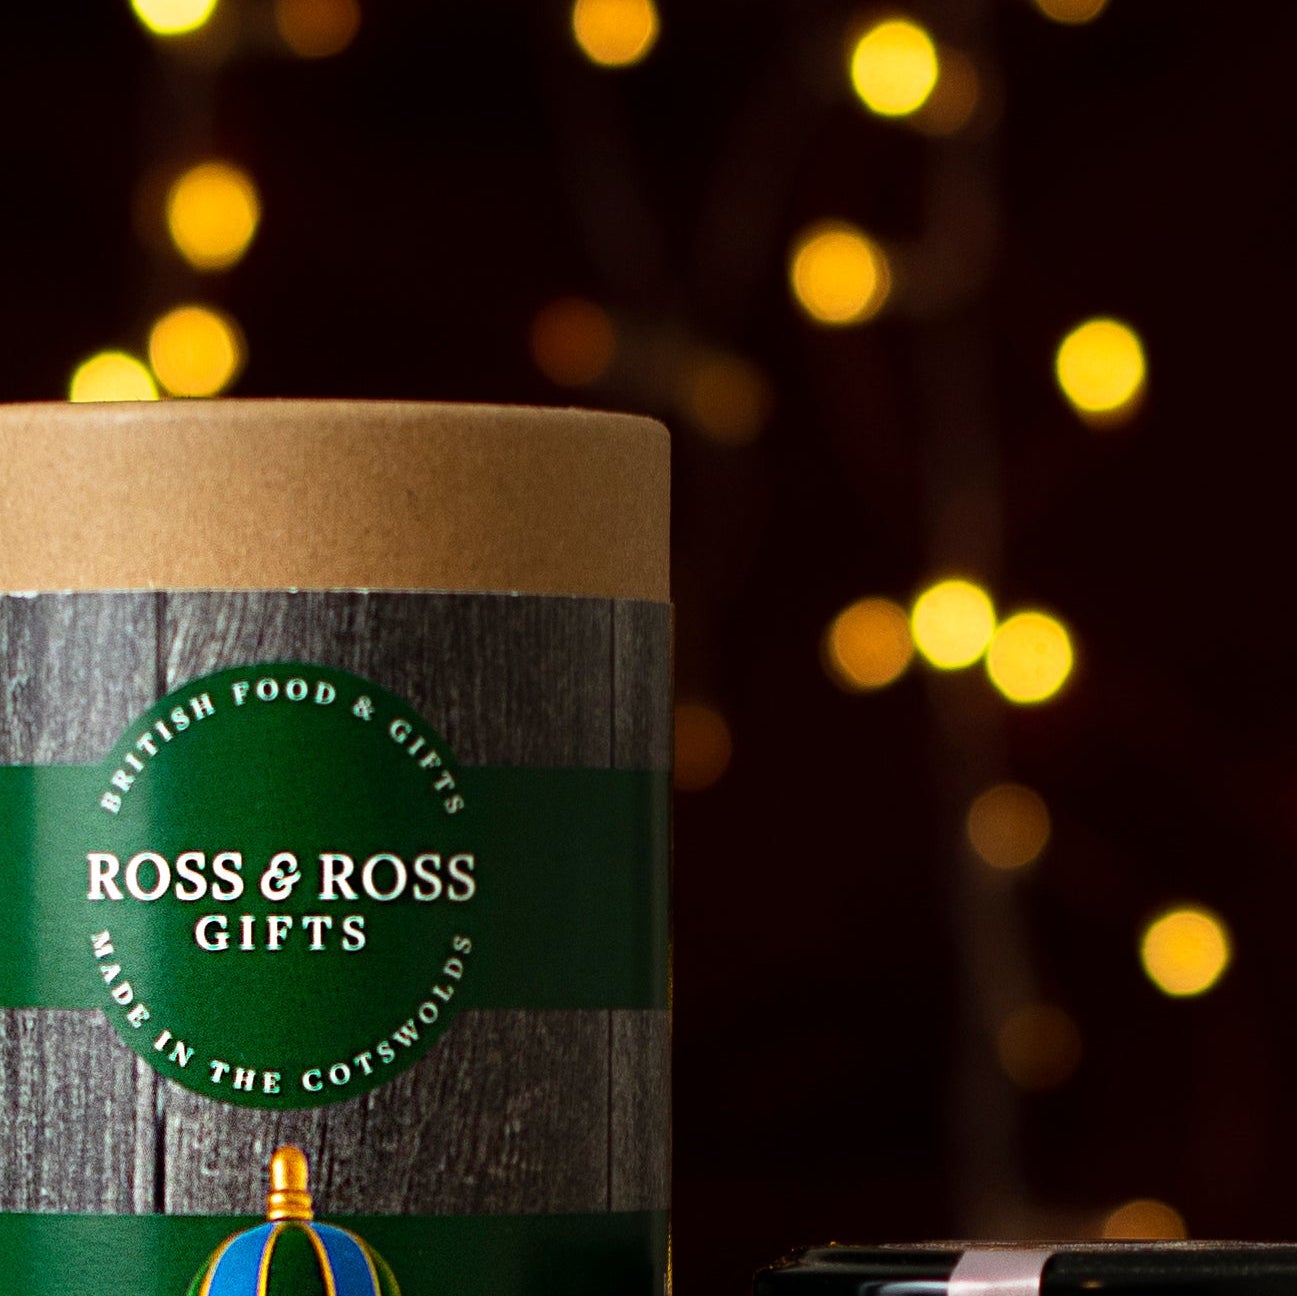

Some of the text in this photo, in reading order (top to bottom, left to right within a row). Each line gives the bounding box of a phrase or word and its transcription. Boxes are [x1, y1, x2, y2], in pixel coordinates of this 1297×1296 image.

[100, 677, 465, 815] BRITISH FOOD & GIFTS
[85, 852, 474, 901] ROSS & ROSS
[195, 915, 366, 951] GIFTS
[90, 929, 472, 1094] MADE IN THE COTSWOLDS
